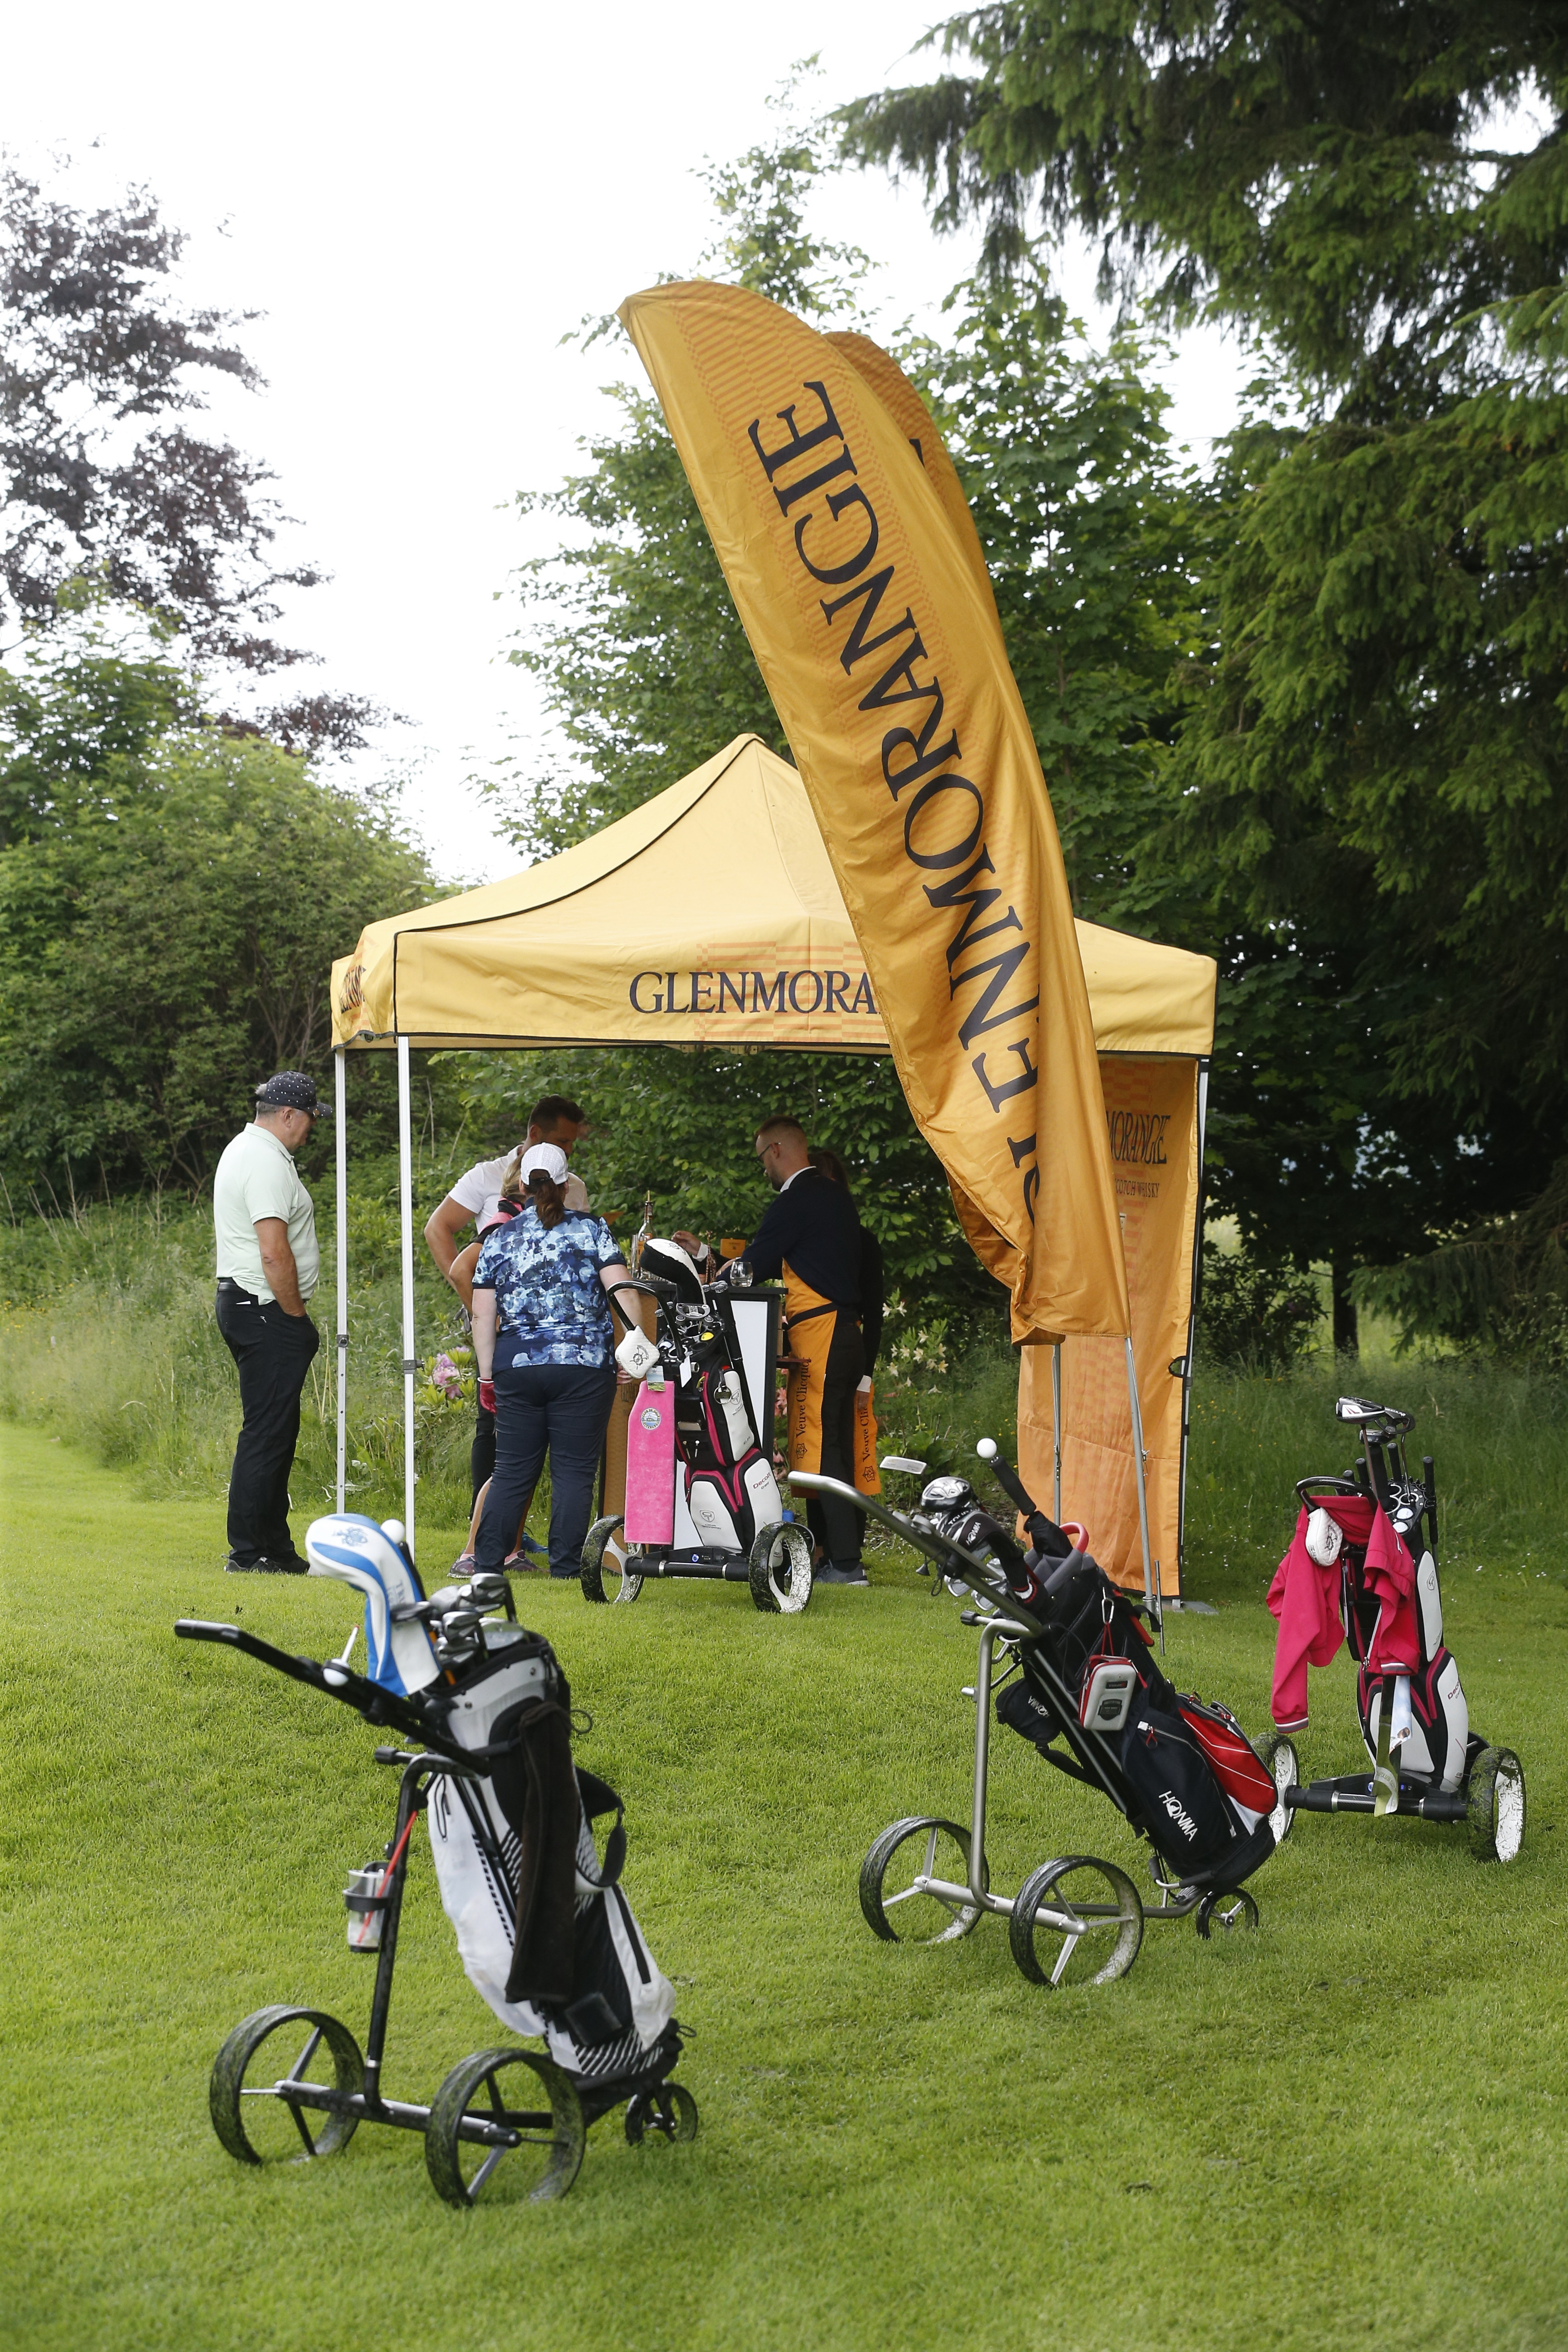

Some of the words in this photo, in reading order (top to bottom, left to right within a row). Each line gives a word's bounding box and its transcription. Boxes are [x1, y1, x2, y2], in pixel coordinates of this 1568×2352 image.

[629, 970, 881, 1014] GLENMORA
[1115, 1179, 1136, 1196] COTCH
[1137, 1181, 1160, 1198] WHISKY
[796, 1405, 806, 1439] Veuve
[753, 1472, 771, 1489] Decolt
[966, 1522, 981, 1545] HONMA
[1028, 1695, 1050, 1717] HONMA
[1159, 1790, 1198, 1842] HONMA
